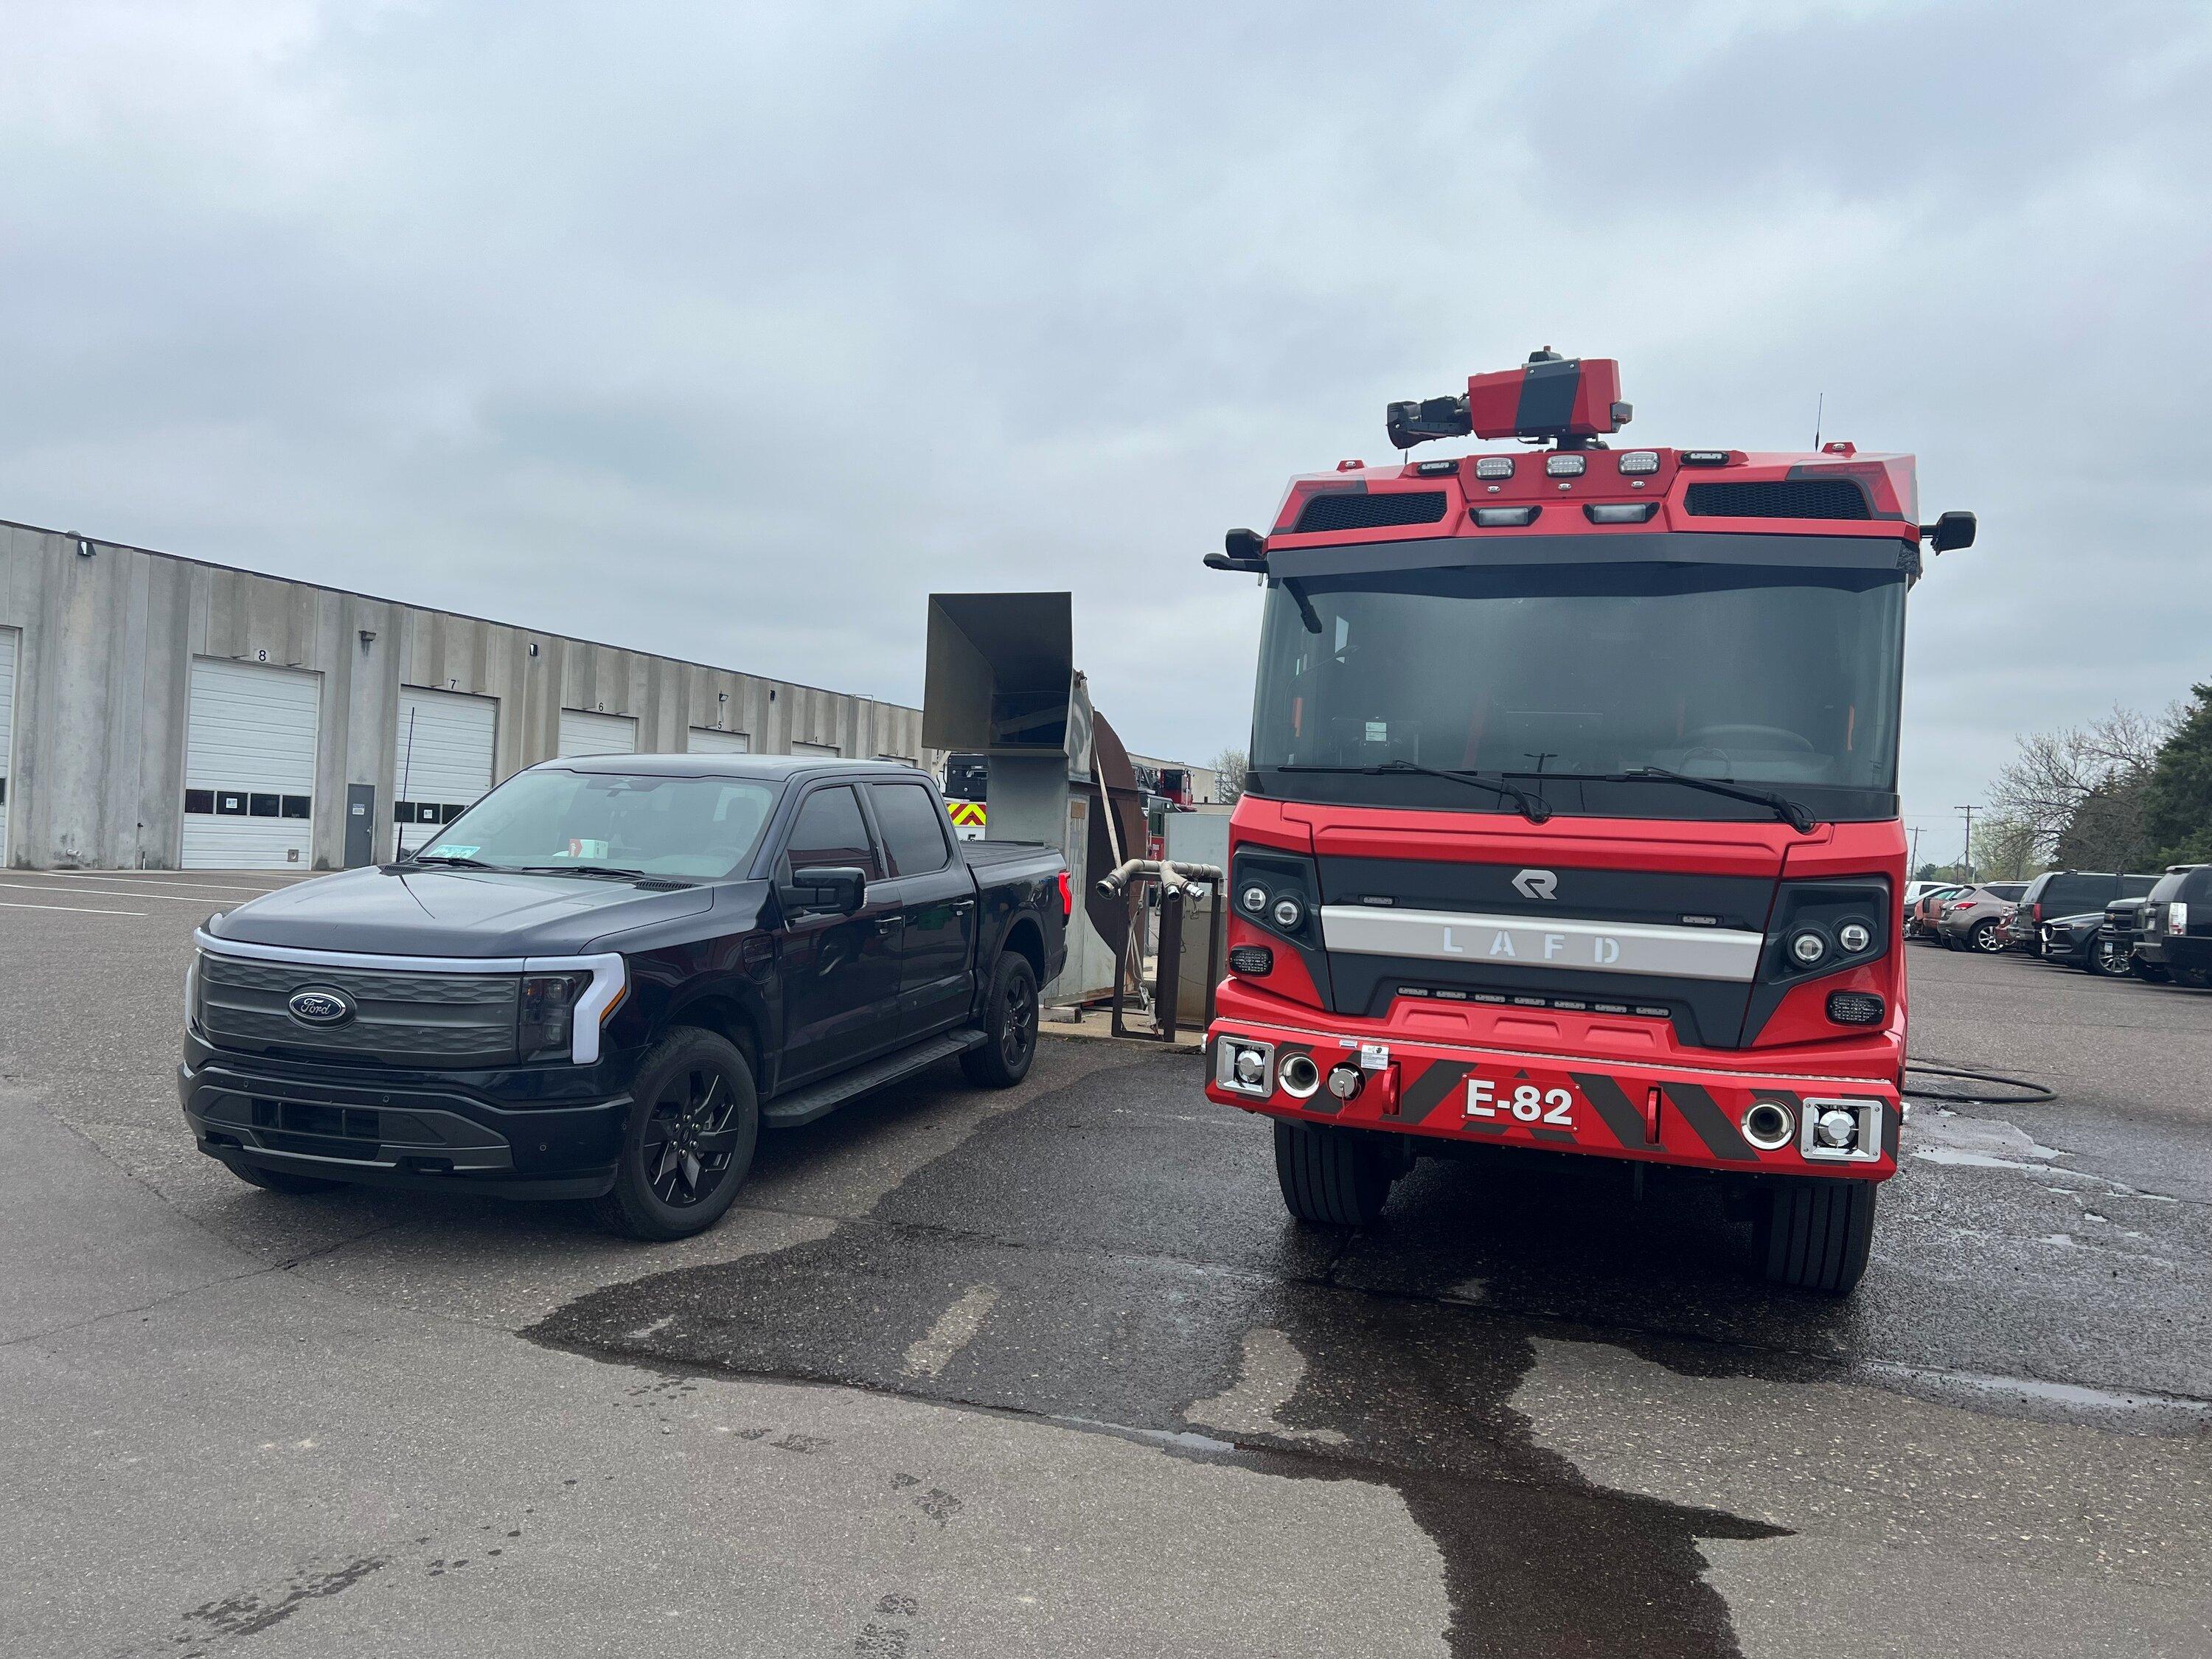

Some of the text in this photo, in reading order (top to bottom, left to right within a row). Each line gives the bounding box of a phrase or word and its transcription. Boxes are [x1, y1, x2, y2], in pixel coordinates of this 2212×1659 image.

[259, 650, 266, 661] 8
[451, 679, 456, 689] 7
[599, 702, 604, 712] 6
[717, 720, 723, 729] 5
[1443, 925, 1621, 964] LAFD
[300, 998, 331, 1015] Ford
[1467, 1079, 1573, 1126] E-82
